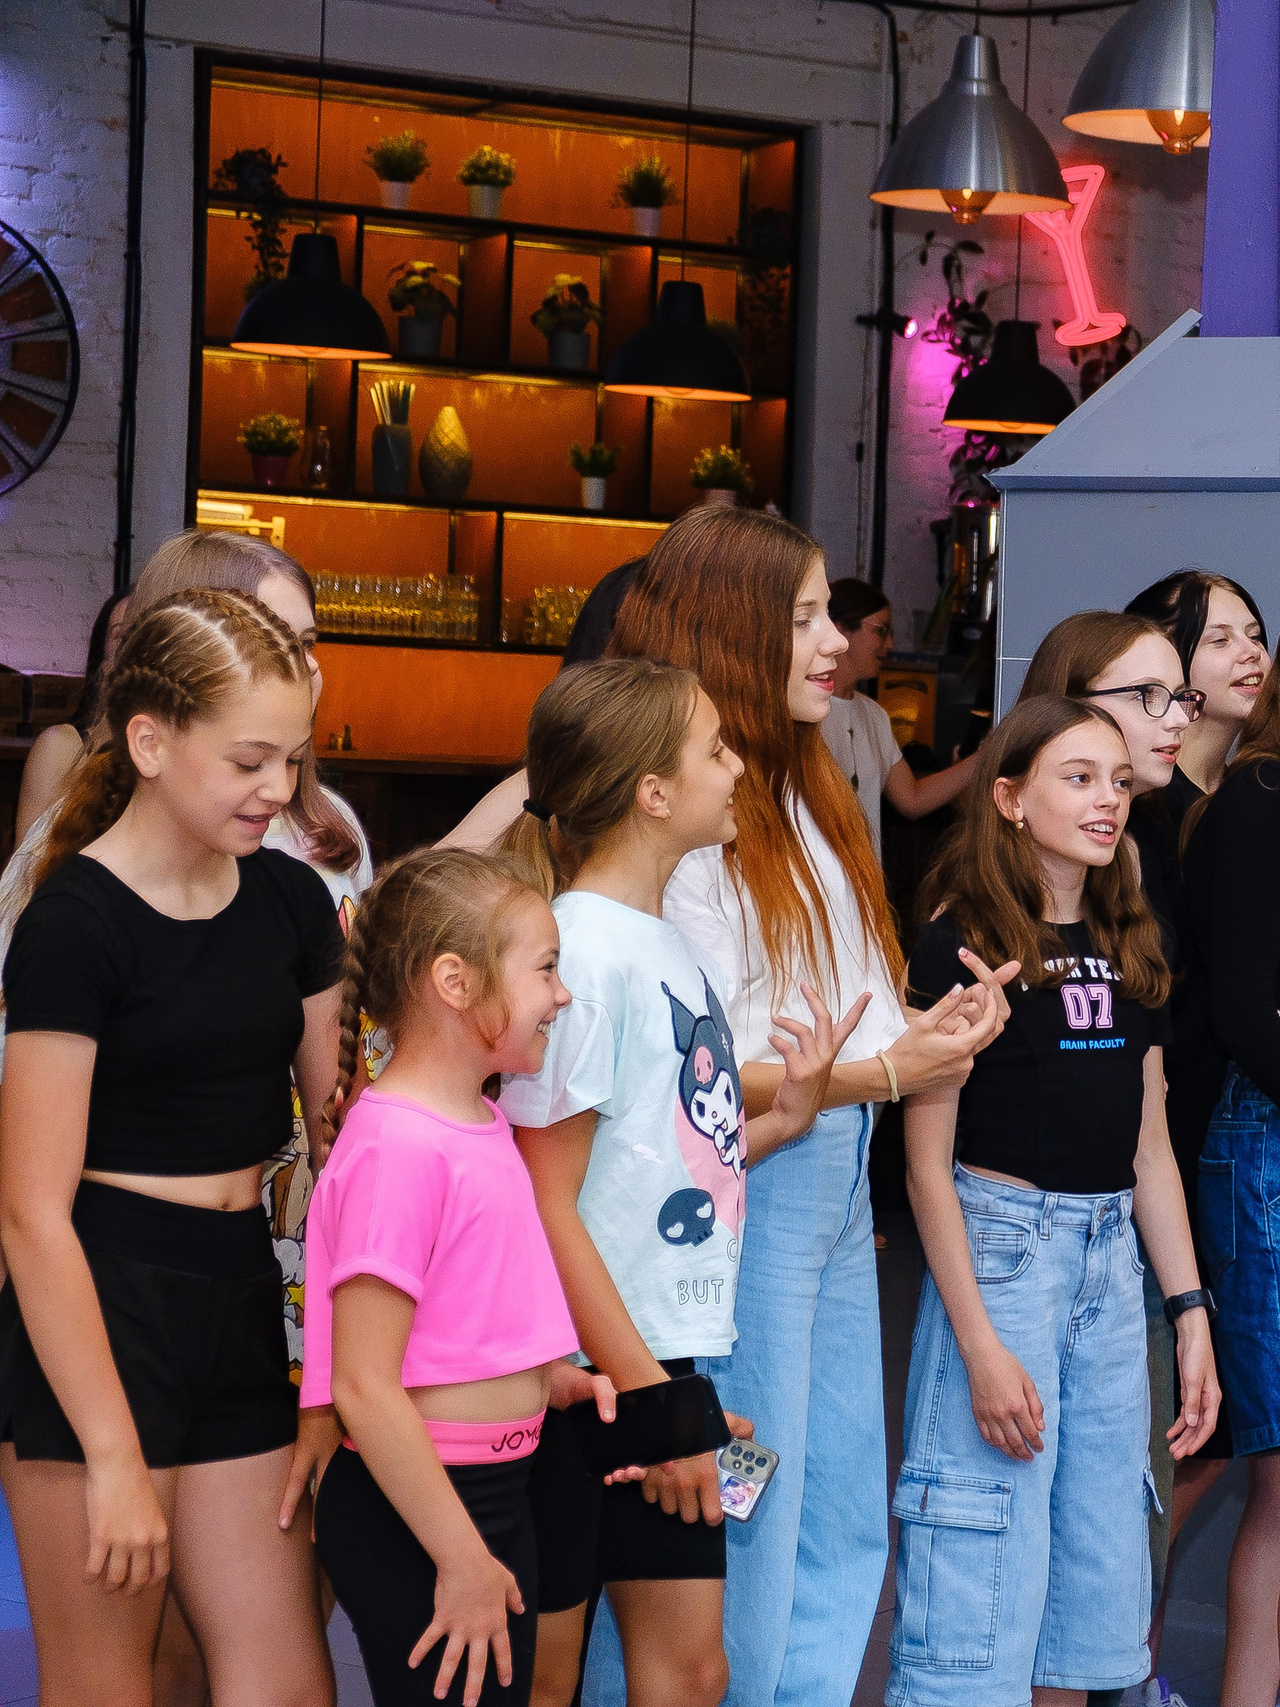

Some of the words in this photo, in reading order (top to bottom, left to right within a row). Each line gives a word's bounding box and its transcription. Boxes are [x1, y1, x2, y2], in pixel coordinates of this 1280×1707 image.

[1061, 984, 1113, 1029] 07
[1060, 1040, 1087, 1050] BRAIN
[1089, 1038, 1126, 1050] FACULTY
[677, 1279, 724, 1305] BUT
